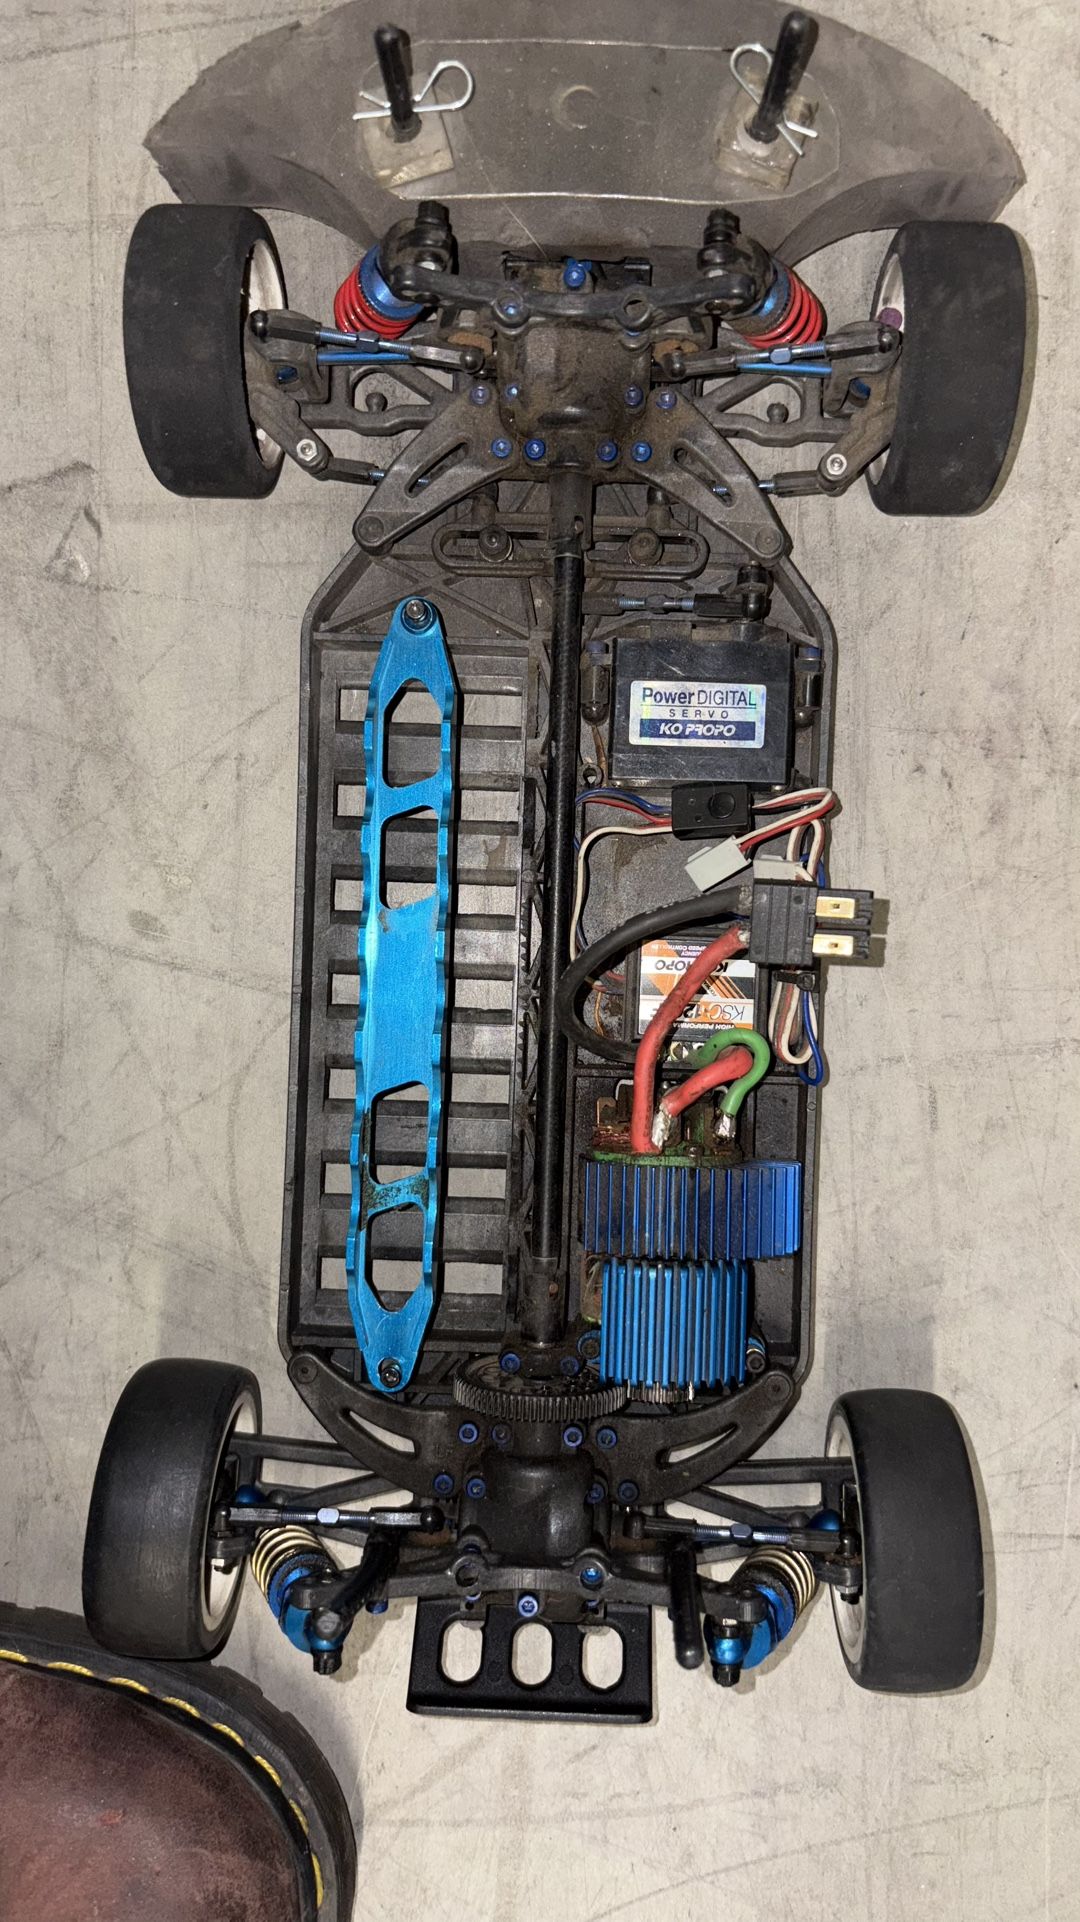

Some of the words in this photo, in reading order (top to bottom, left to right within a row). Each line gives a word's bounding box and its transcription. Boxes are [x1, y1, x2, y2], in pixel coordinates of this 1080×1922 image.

[642, 687, 695, 704] Power
[697, 689, 757, 706] DIGITAL
[669, 709, 729, 719] SERVO
[659, 722, 683, 735] KO
[685, 723, 736, 736] PROPO
